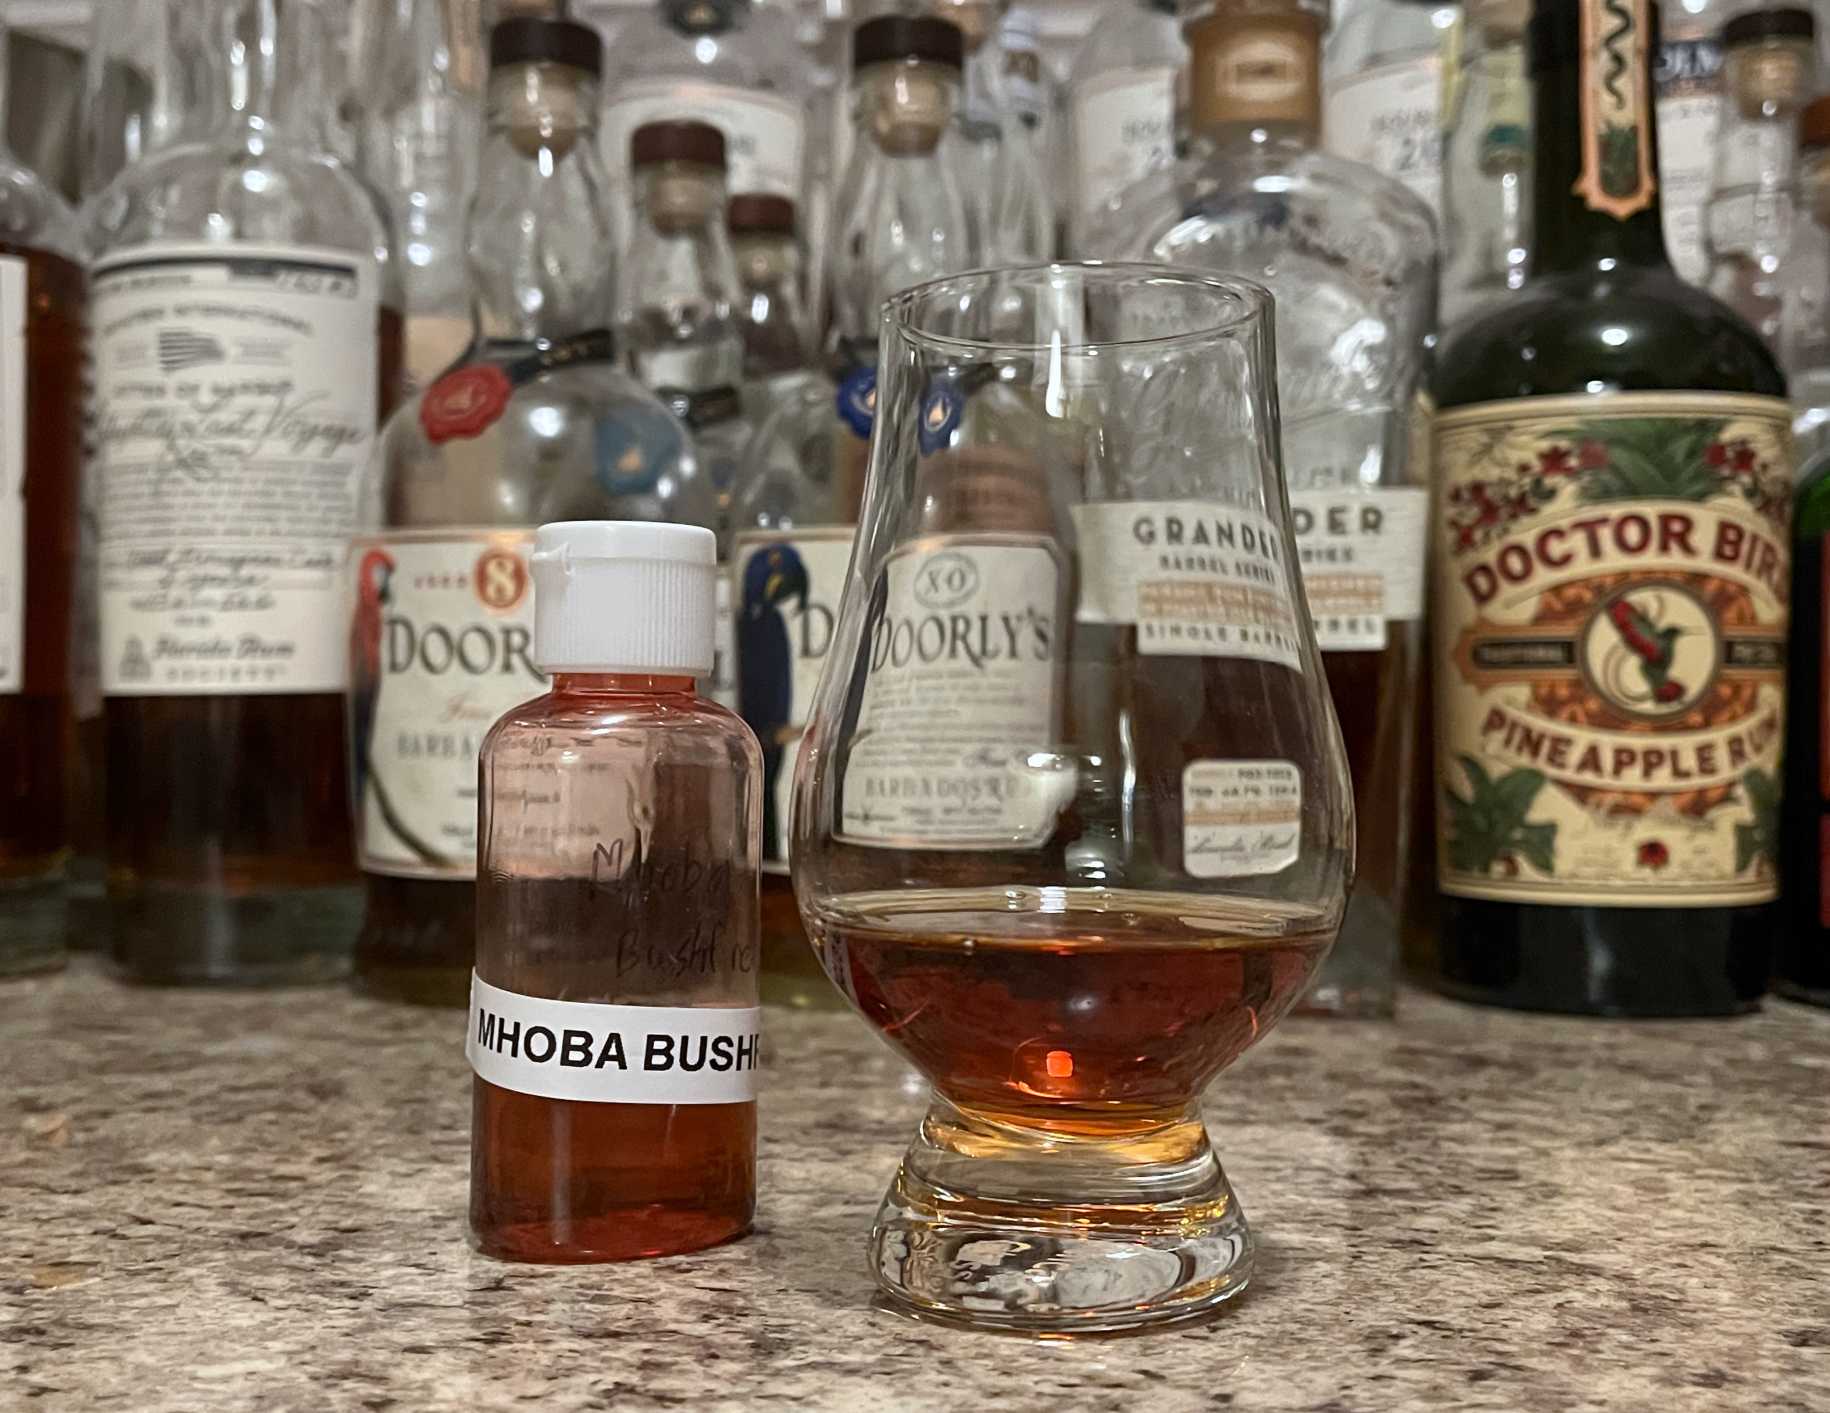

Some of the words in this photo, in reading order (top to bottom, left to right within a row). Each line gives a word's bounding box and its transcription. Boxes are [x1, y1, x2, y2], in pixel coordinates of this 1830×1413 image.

[1462, 513, 1698, 606] DOCTOR
[1713, 519, 1786, 597] BIR
[870, 605, 1050, 672] DOORLY'S
[1481, 706, 1718, 780] PINEAPPLE
[477, 1008, 628, 1071] MHOBA
